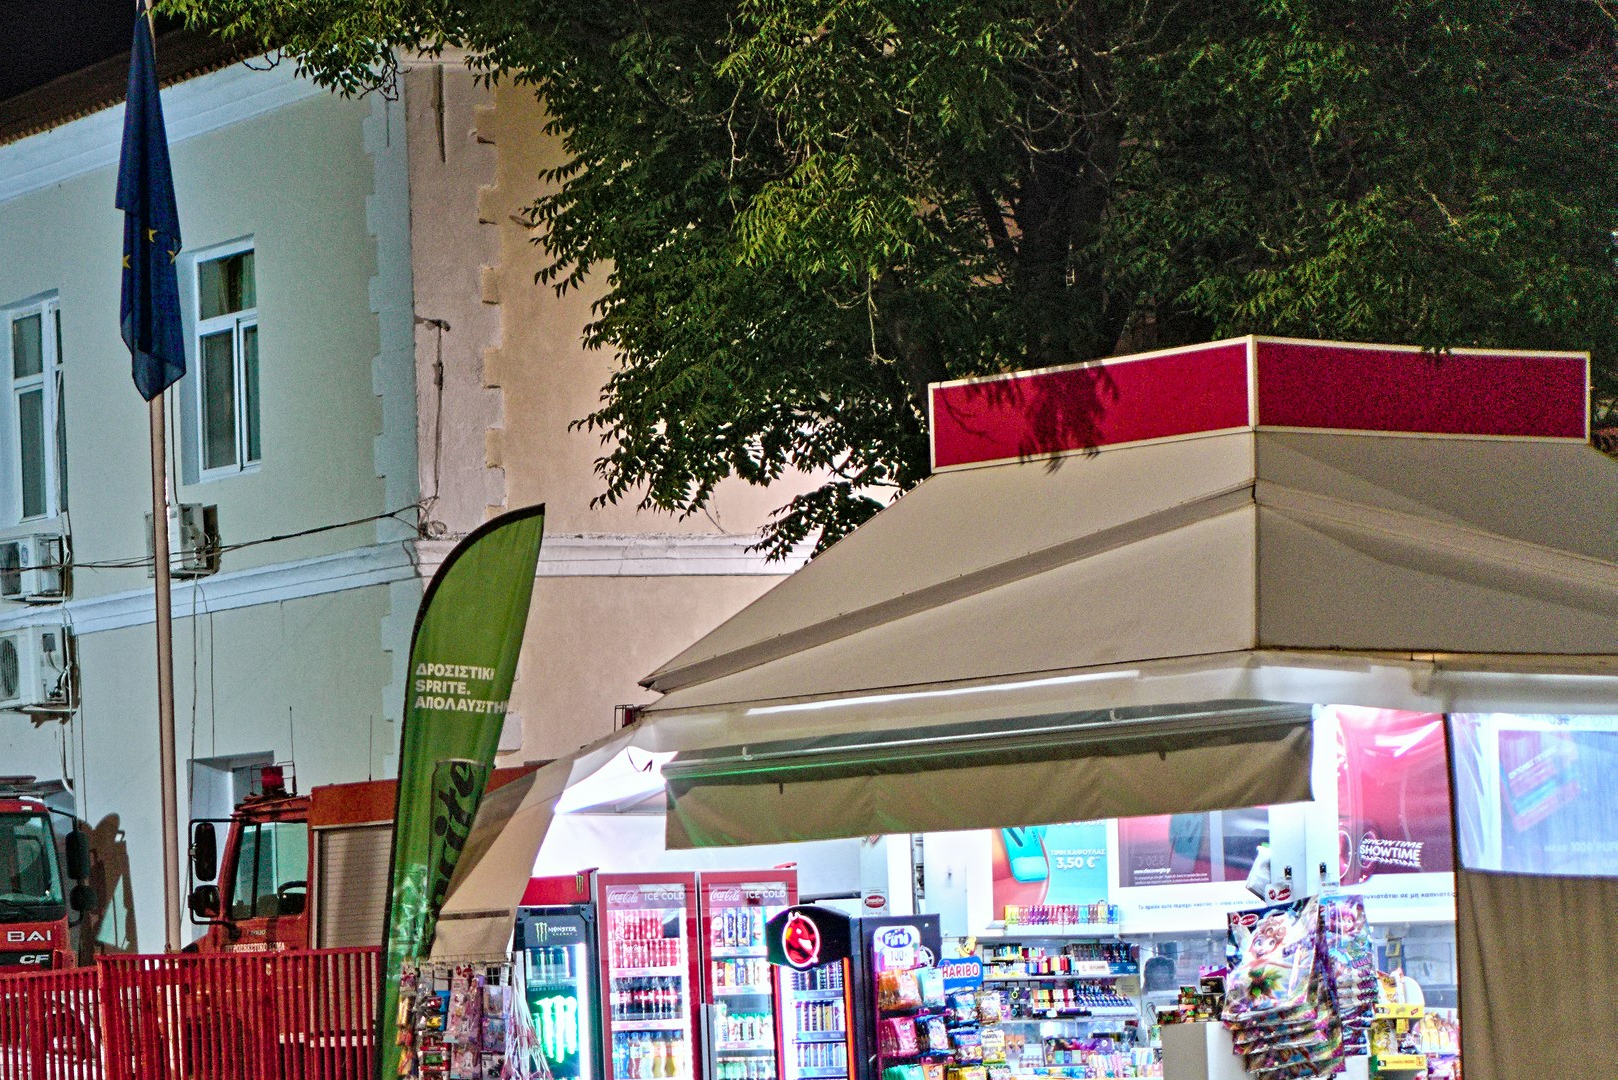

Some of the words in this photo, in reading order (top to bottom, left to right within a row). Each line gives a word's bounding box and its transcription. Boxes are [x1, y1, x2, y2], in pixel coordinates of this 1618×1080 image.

[415, 680, 472, 696] SPRITE.
[1359, 844, 1421, 861] SHOWTIME
[1055, 856, 1084, 872] 3,50
[644, 891, 659, 901] ICE
[661, 891, 685, 901] COLD
[746, 890, 761, 899] ICE
[763, 889, 786, 899] COLD
[7, 930, 51, 942] BAI
[19, 954, 50, 965] CF
[942, 963, 979, 978] HARIBO
